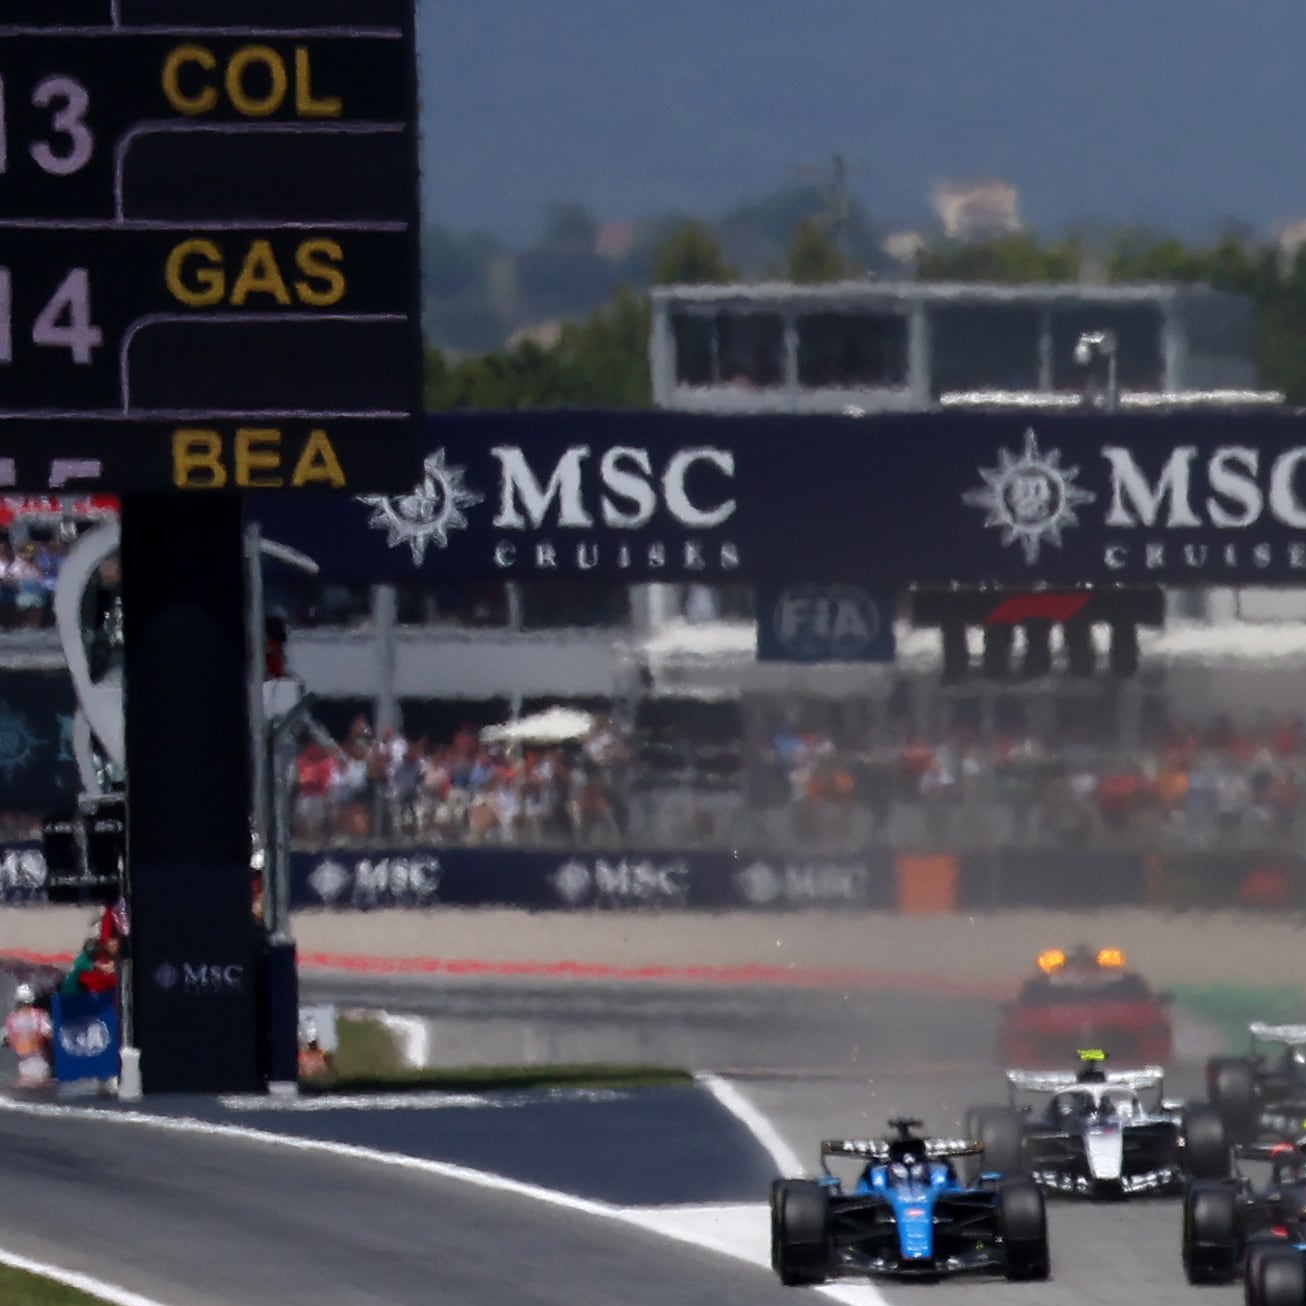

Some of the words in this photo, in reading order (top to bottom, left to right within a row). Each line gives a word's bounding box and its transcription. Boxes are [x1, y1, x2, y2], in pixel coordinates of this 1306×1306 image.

[162, 44, 342, 118] COL
[165, 238, 346, 307] GAS
[171, 428, 346, 488] BEA
[491, 445, 737, 529] MSC
[494, 540, 740, 569] CRUISES
[779, 600, 870, 639] FIA
[182, 961, 243, 985] MSC
